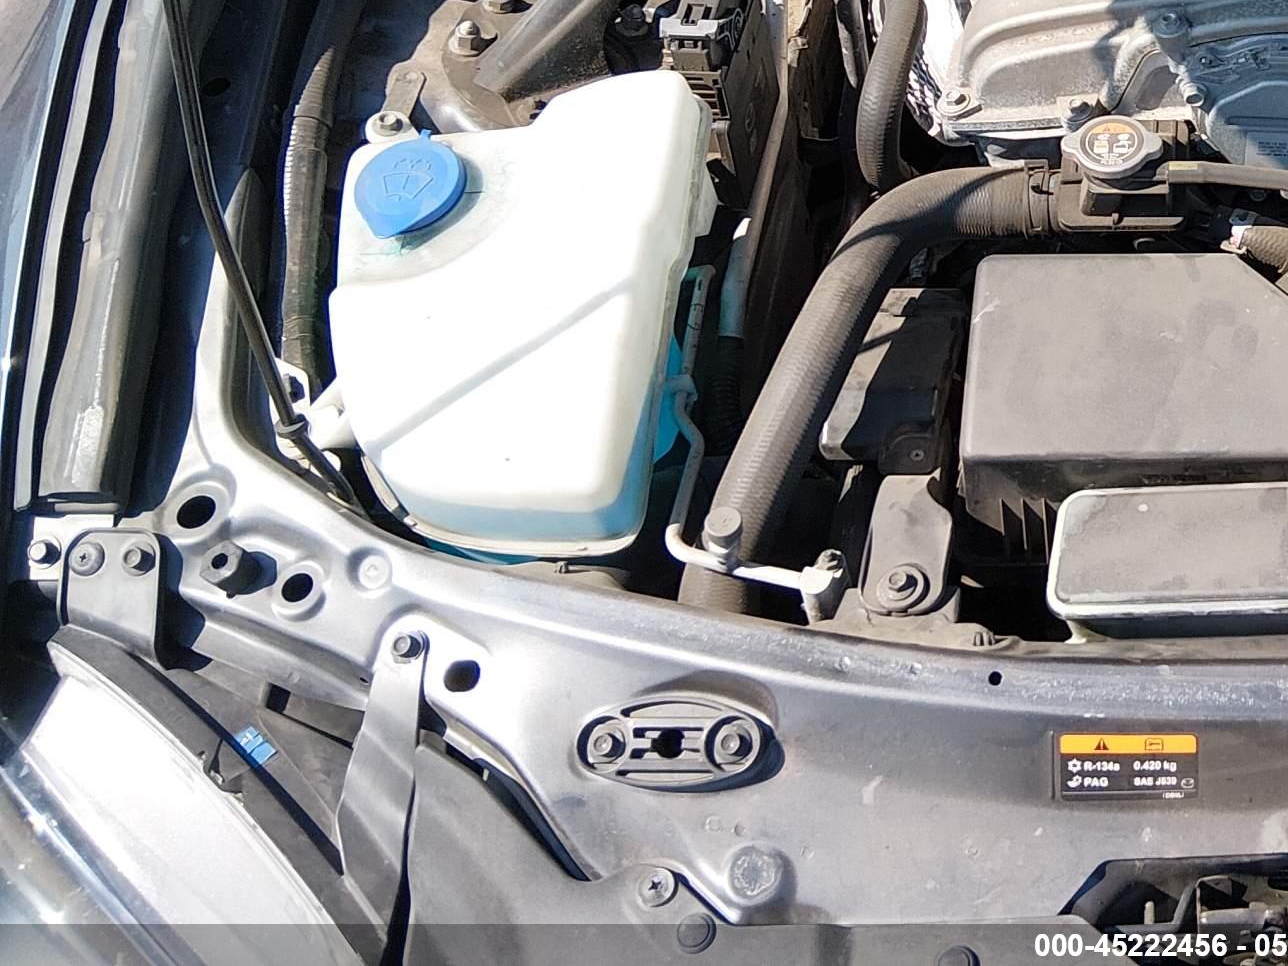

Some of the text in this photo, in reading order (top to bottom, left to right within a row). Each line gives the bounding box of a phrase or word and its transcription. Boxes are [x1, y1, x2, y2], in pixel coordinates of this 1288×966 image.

[1083, 760, 1177, 773] R-134a 0.420 kg
[1083, 776, 1109, 788] PAG
[1133, 776, 1154, 787] SAE
